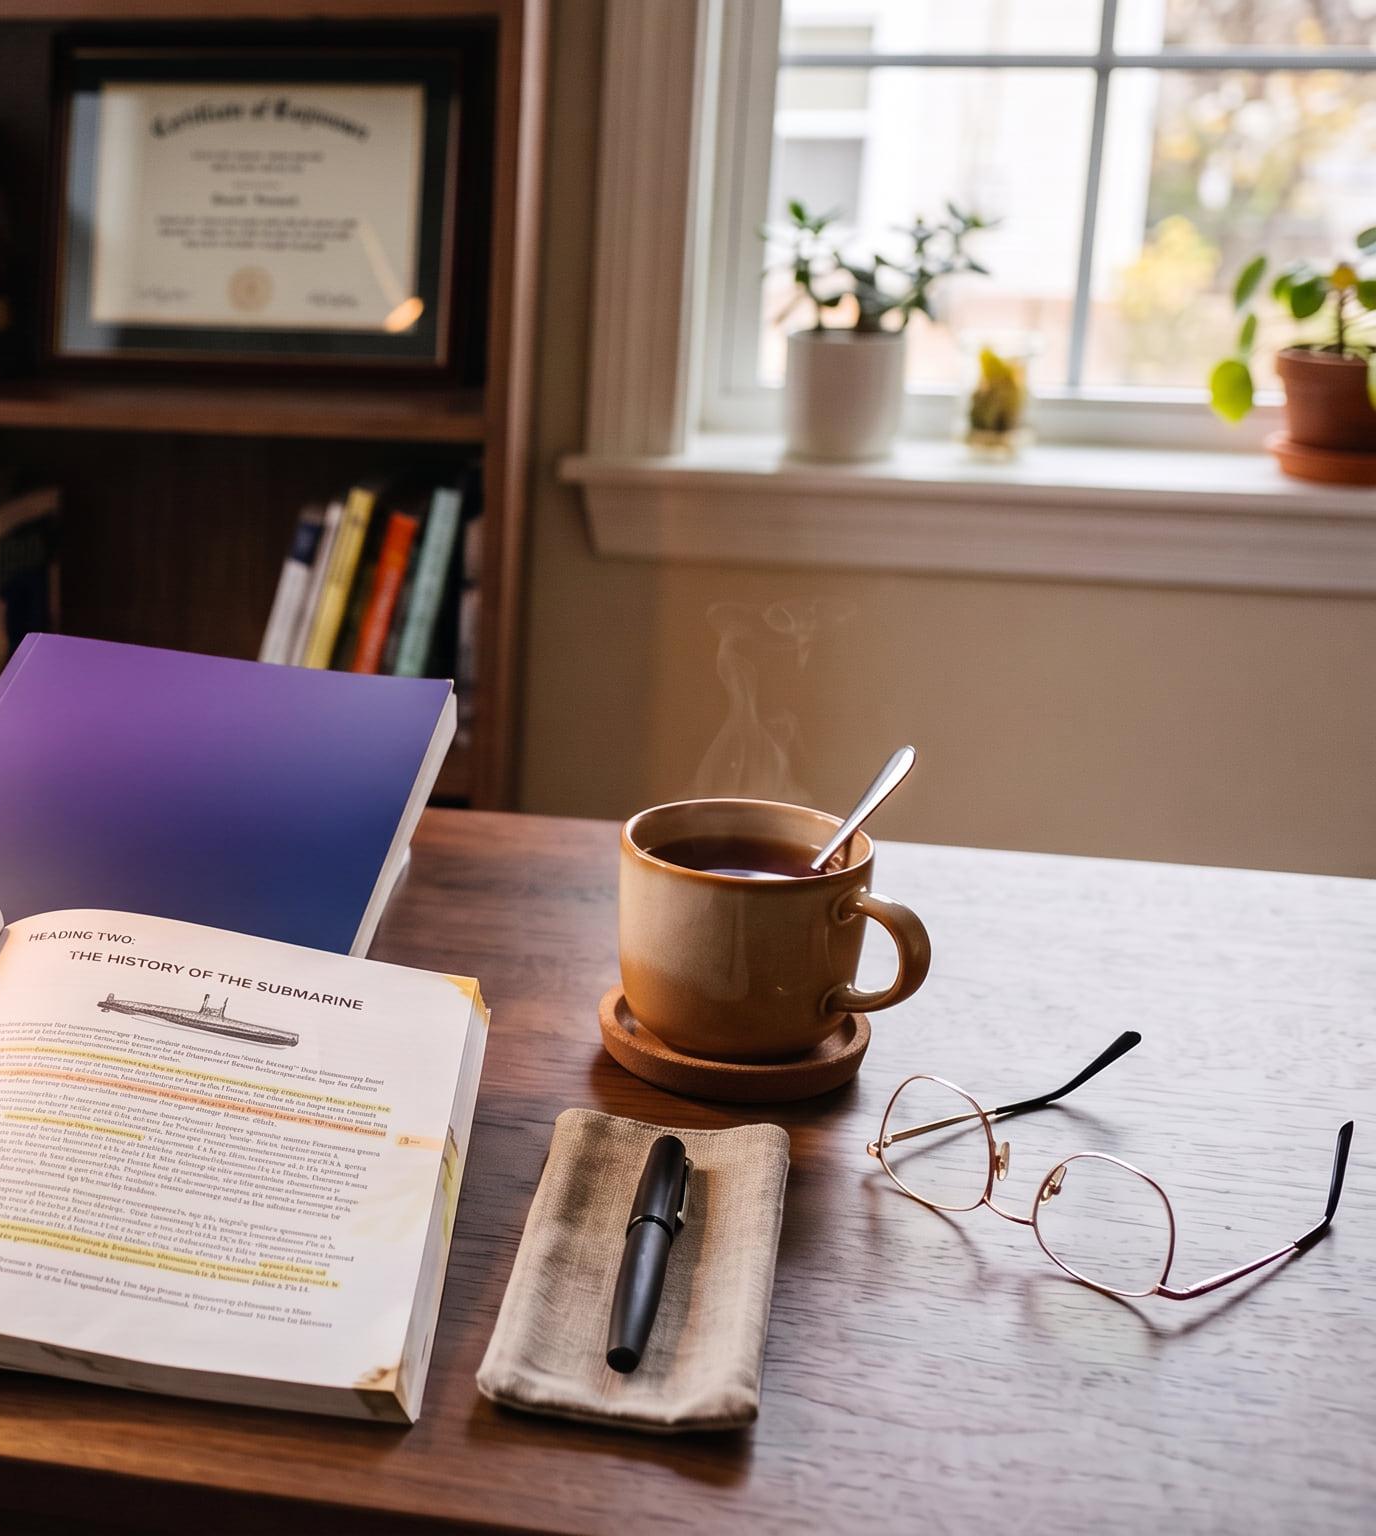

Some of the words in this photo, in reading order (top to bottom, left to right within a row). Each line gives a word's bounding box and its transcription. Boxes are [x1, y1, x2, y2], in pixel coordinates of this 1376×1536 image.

[28, 930, 94, 942] HEADING
[97, 931, 136, 945] TWO:
[69, 950, 104, 962] THE
[107, 953, 185, 975] HISTORY
[188, 967, 215, 980] OF
[217, 972, 253, 990] THE
[256, 981, 364, 1011] SUBMARINE
